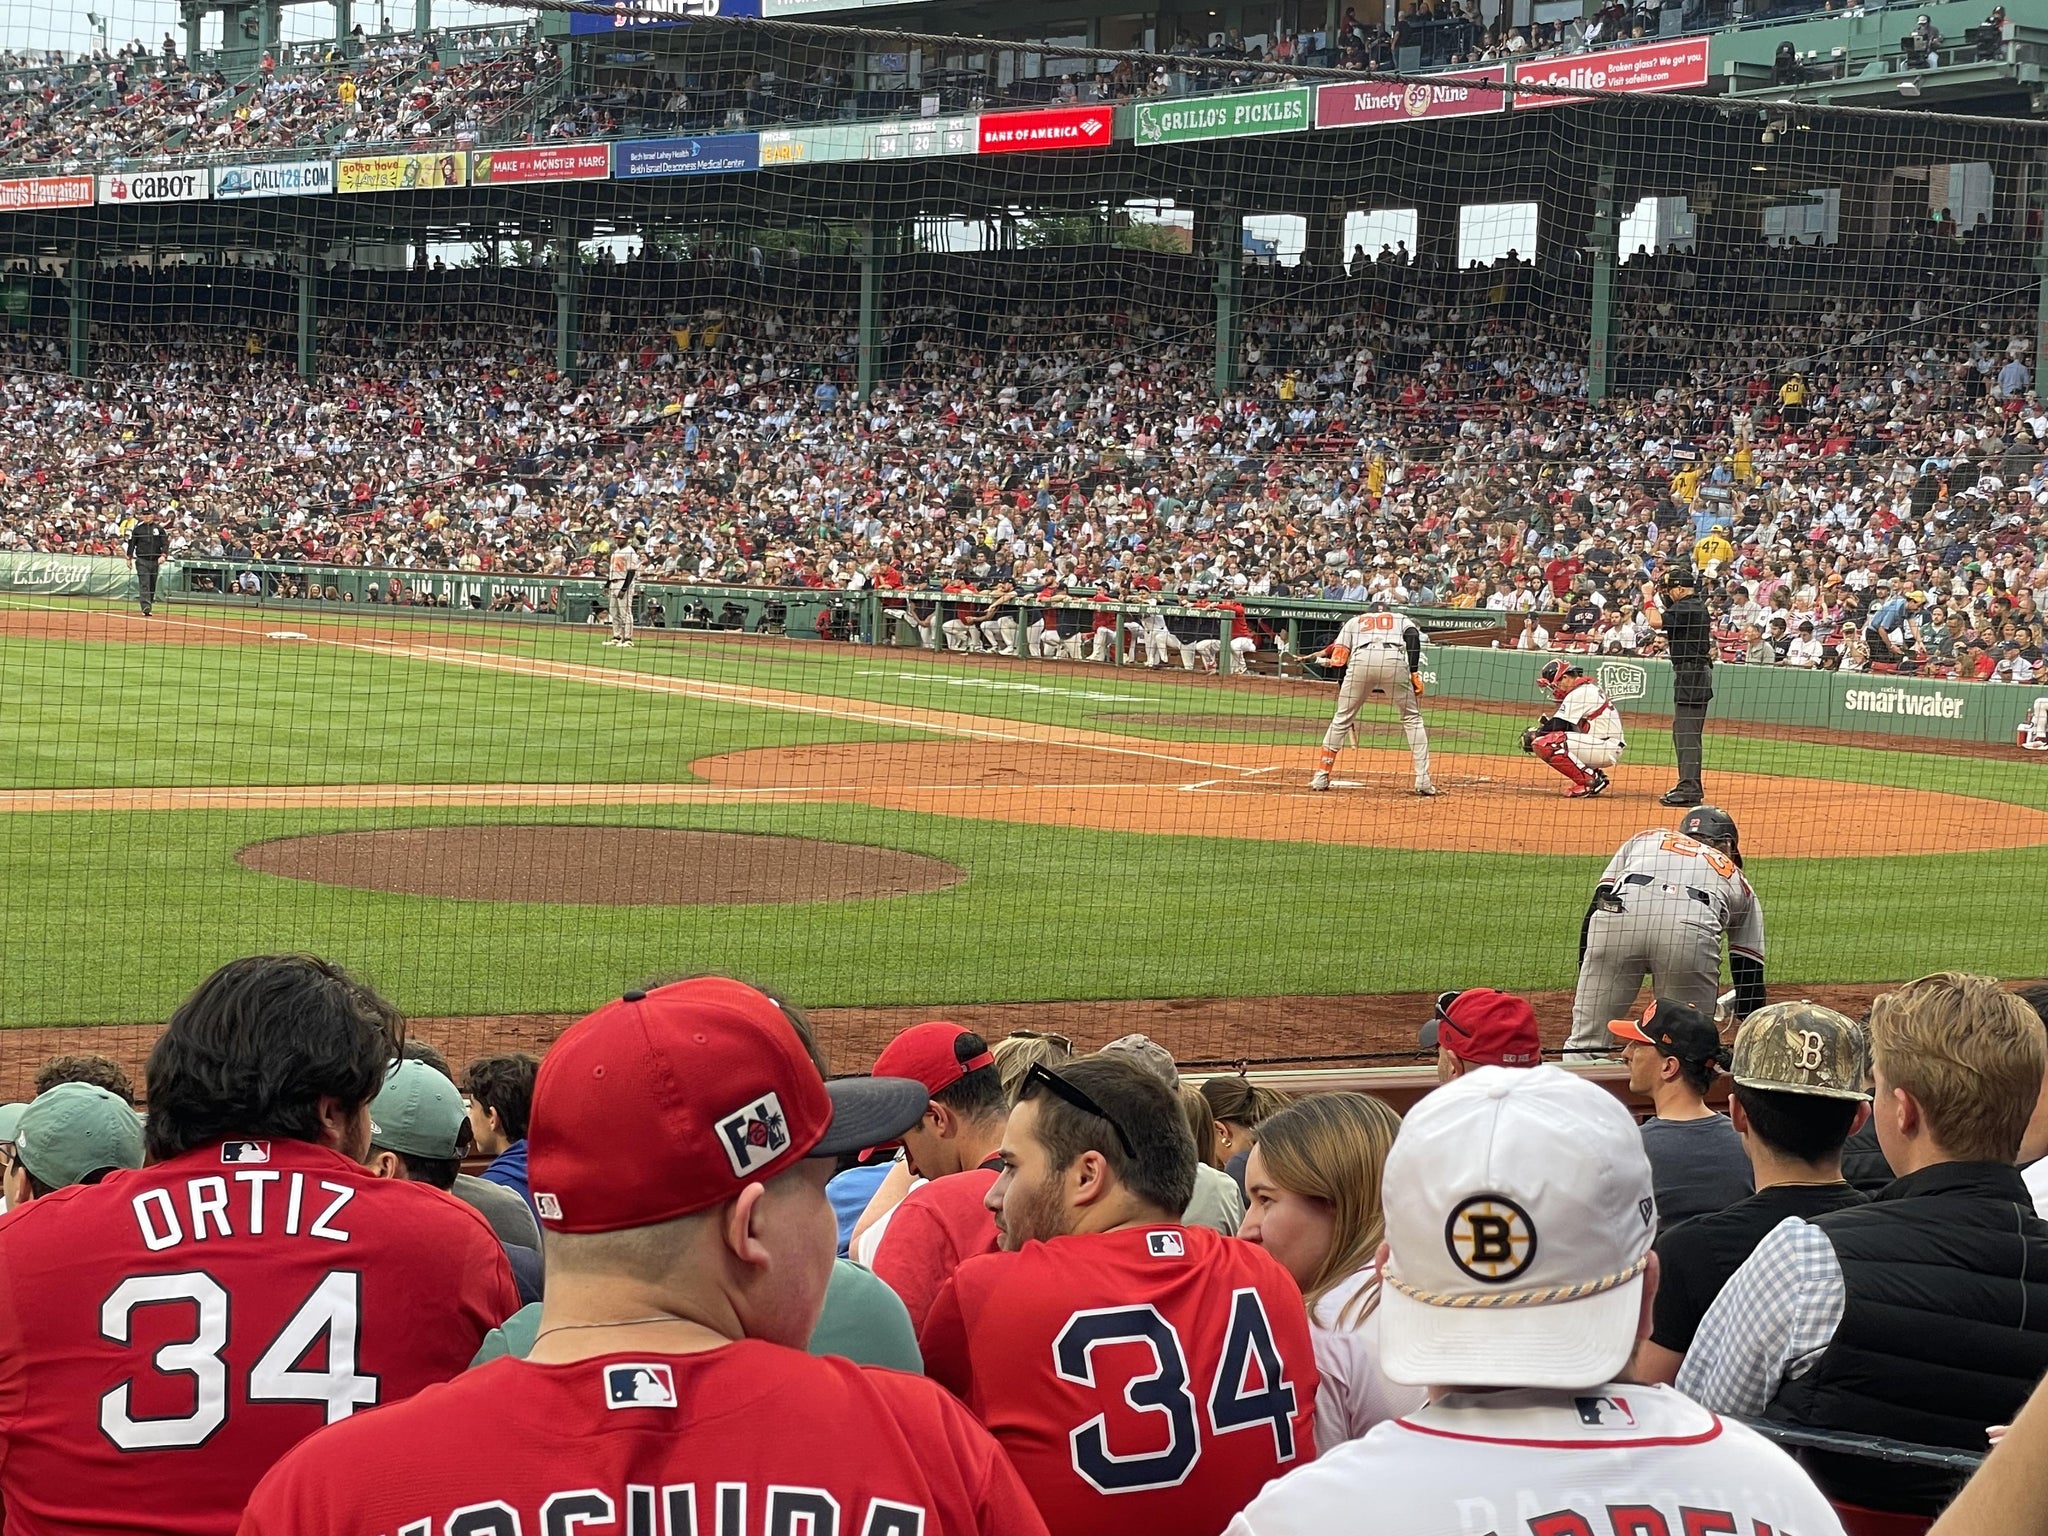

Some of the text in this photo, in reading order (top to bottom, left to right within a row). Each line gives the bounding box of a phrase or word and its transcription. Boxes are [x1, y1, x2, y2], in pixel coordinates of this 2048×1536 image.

[1608, 54, 1703, 73] Broken glass? We got you.
[1608, 72, 1669, 87] Visit safelite.com
[1354, 91, 1404, 111] Ninety
[1432, 85, 1468, 104] Nine
[1161, 100, 1303, 131] GRILLO'S PICKLES
[985, 126, 1078, 142] BANK OF AMERICA
[882, 139, 896, 153] 34
[343, 161, 371, 176] gotta
[493, 161, 518, 172] MAKE
[533, 158, 575, 171] MONSTER
[578, 156, 606, 168] MARG
[663, 162, 697, 172] Deaconess
[697, 160, 722, 171] Medical
[723, 159, 745, 168] Center
[253, 167, 329, 189] CALL128.COM
[0, 181, 90, 206] ing's Hawaiian
[1358, 613, 1394, 633] 30
[1454, 621, 1482, 629] AMERICA
[1607, 667, 1640, 685] ACE
[1607, 685, 1640, 696] TICKET
[1845, 688, 1964, 718] smartwater
[132, 1170, 356, 1252] ORTIZ
[1468, 1214, 1513, 1263] B
[98, 1269, 381, 1453] 34
[1051, 1286, 1299, 1495] 34
